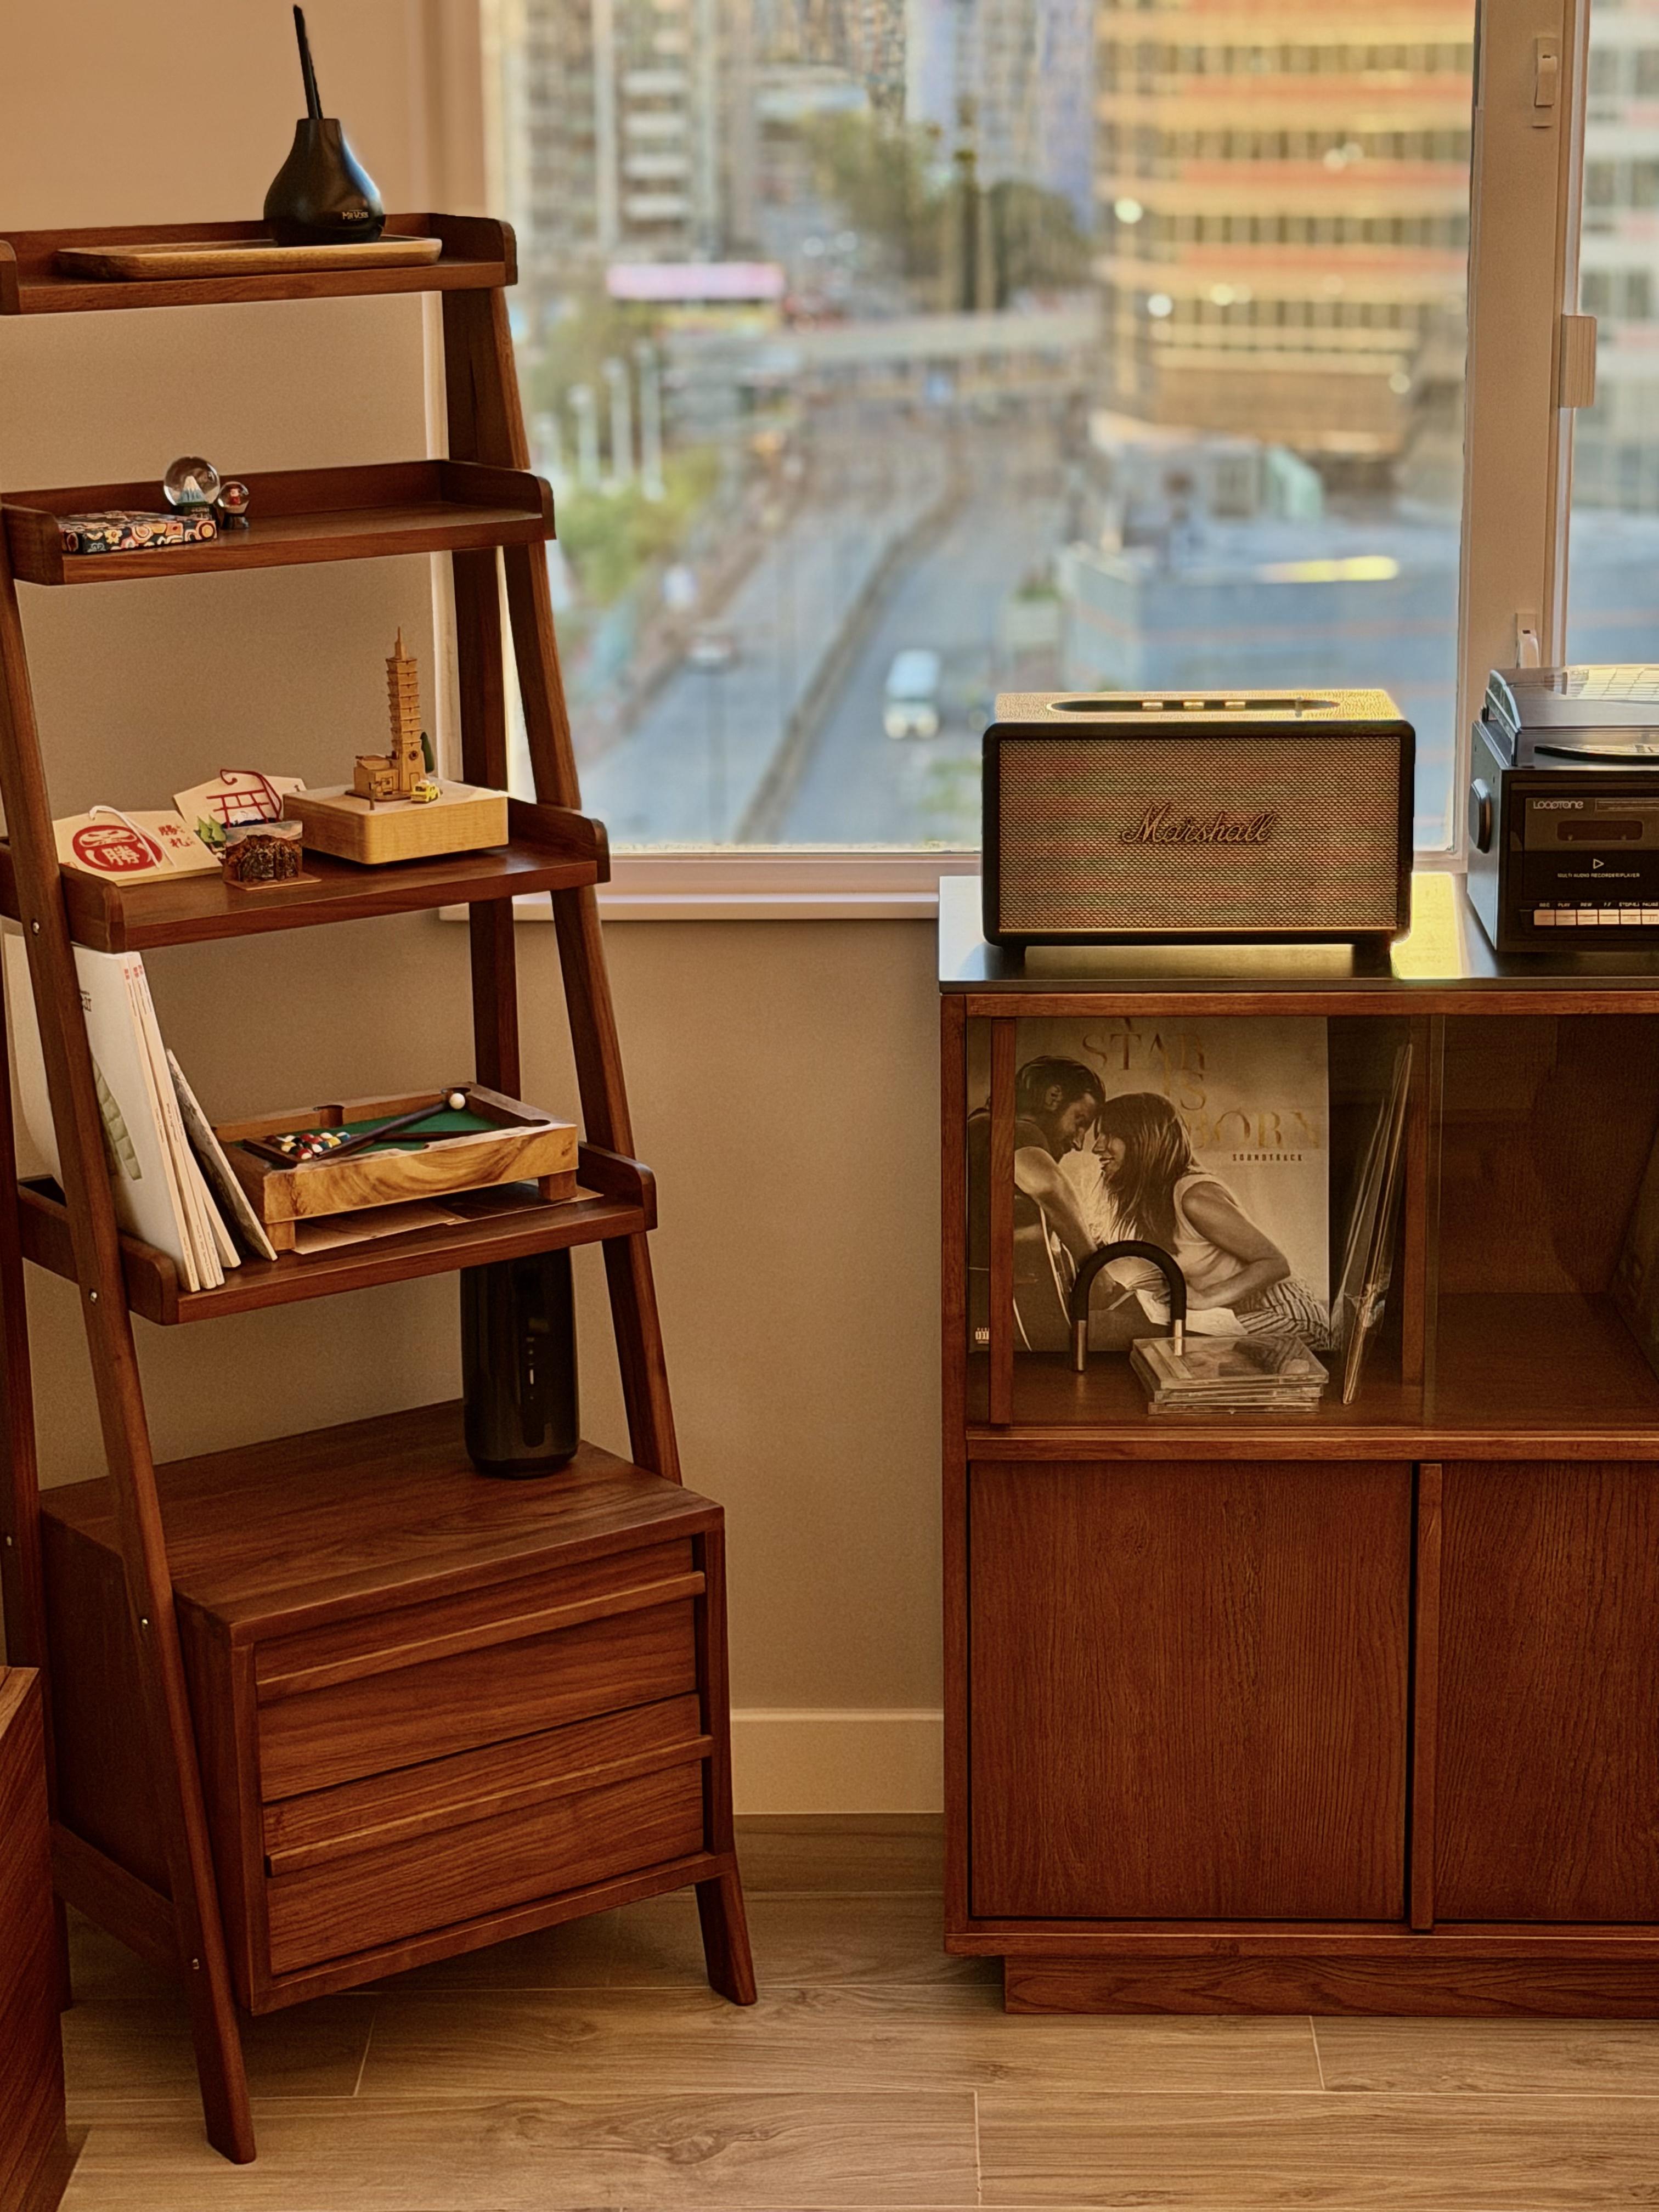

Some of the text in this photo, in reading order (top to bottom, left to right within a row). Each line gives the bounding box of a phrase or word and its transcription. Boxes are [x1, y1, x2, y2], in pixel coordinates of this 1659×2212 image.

[1122, 803, 1277, 843] Marshall
[101, 845, 140, 866] 勝
[1082, 1032, 1206, 1071] STAR
[1186, 1108, 1321, 1150] BORN
[1232, 1153, 1302, 1162] SOUNDTRACK
